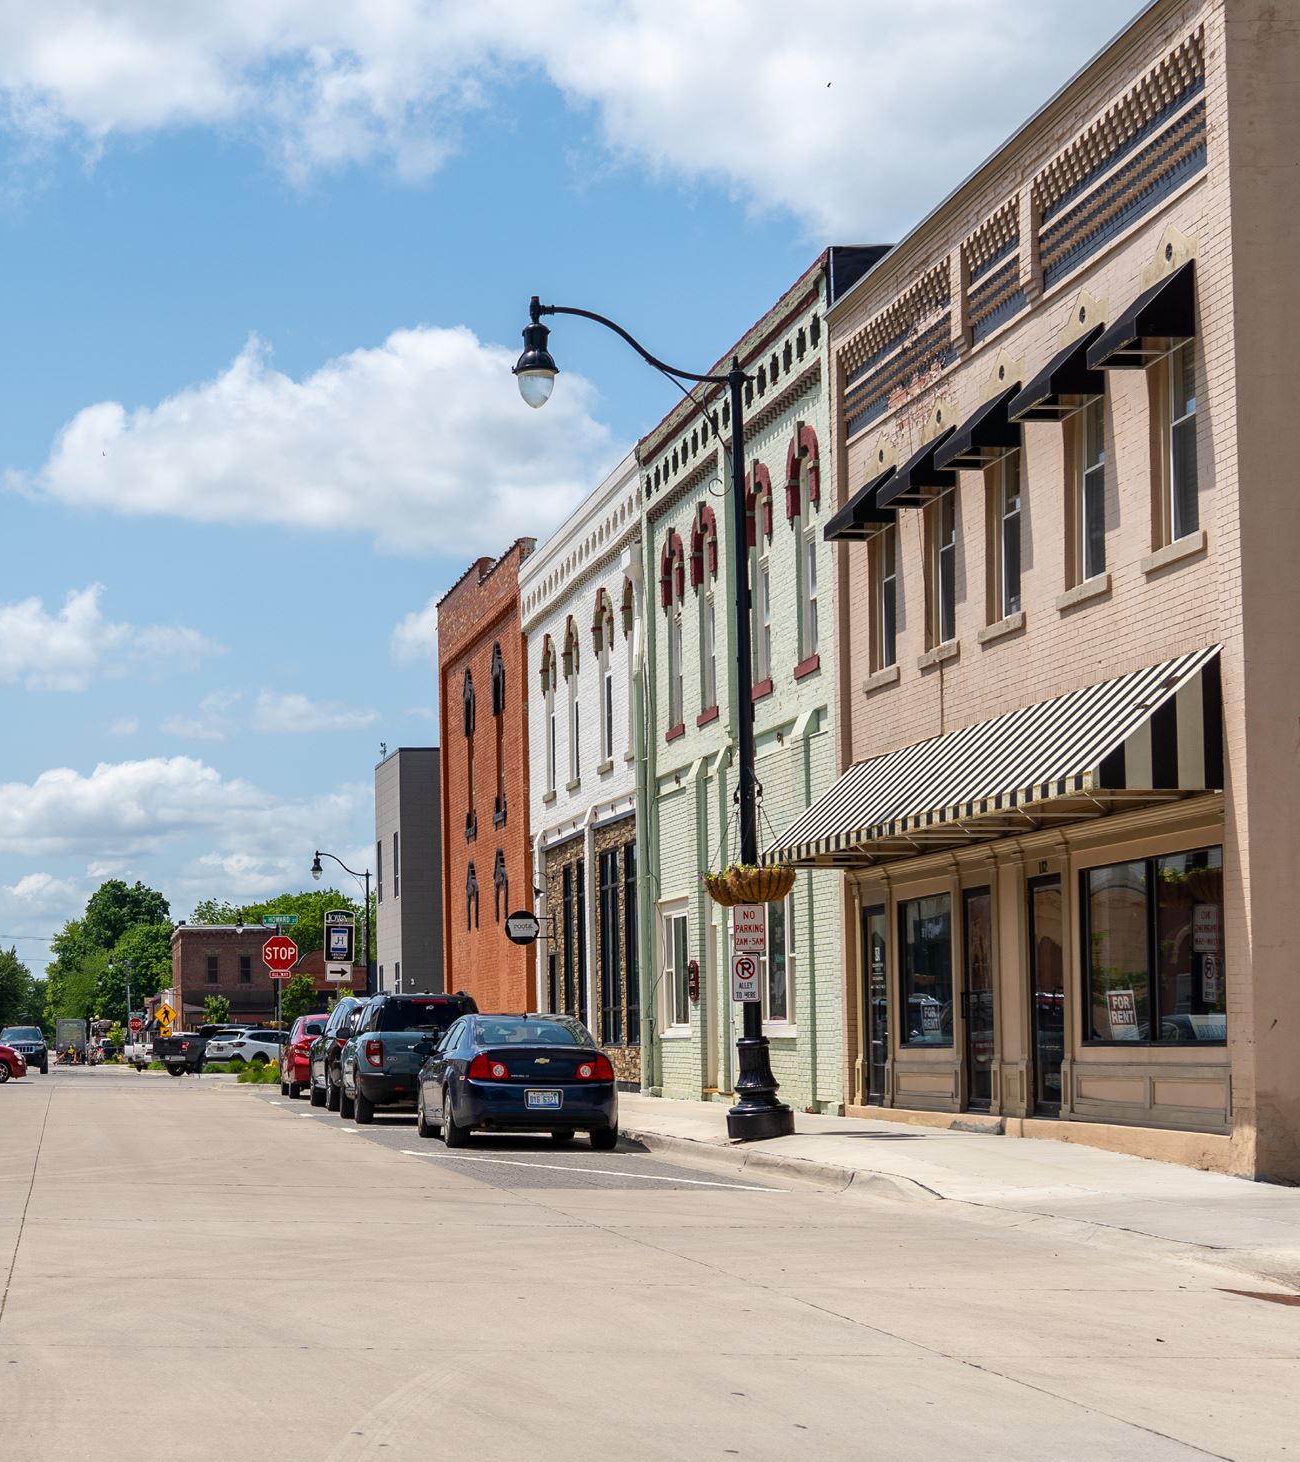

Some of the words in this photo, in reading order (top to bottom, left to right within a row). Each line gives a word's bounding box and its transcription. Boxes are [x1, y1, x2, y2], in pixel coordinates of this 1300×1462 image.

[267, 916, 291, 924] HOWARD
[743, 910, 756, 920] NO
[735, 924, 764, 933] PARKING
[736, 937, 764, 946] 2AM-5AM
[265, 947, 296, 960] STOP
[1112, 996, 1131, 1009] FOR
[924, 1006, 936, 1018] FOR
[1111, 1010, 1134, 1024] RENT
[924, 1018, 939, 1029] RENT
